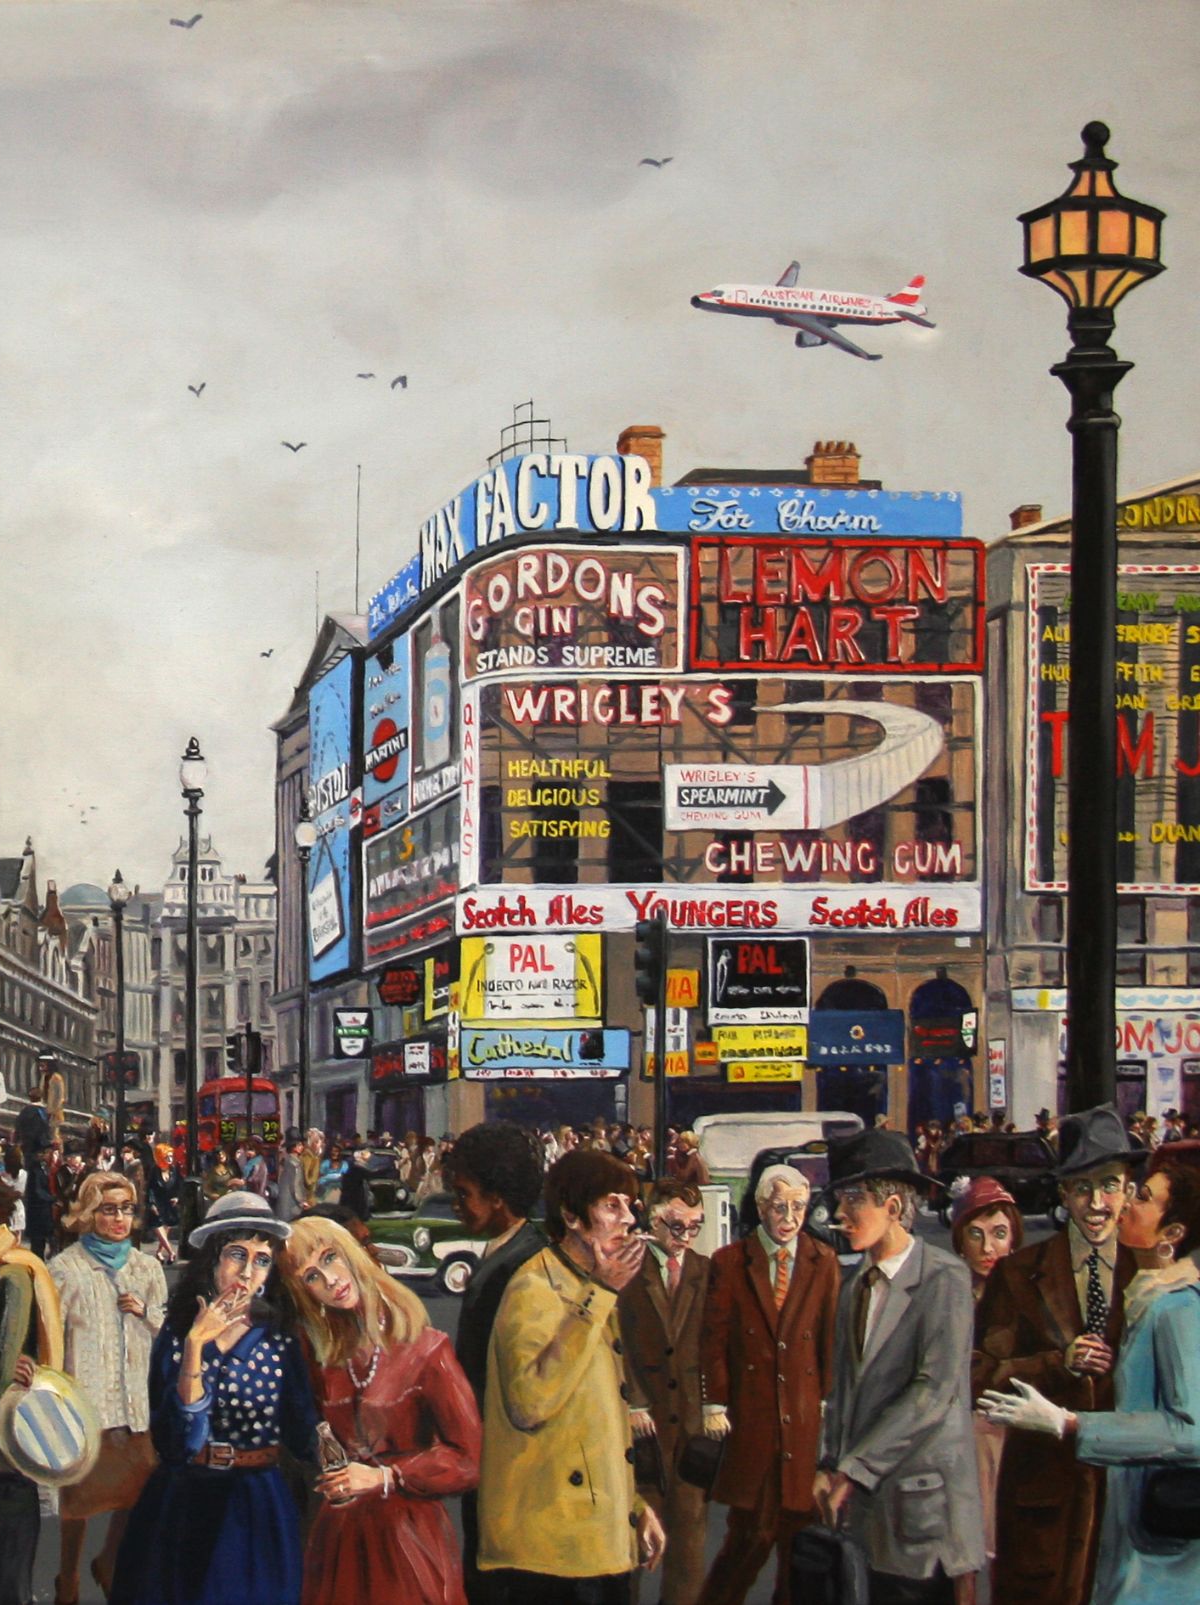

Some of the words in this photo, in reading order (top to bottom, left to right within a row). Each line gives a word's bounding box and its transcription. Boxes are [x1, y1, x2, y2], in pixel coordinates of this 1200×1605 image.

[419, 494, 465, 591] MAX
[475, 453, 658, 548] FACTOR
[688, 498, 755, 533] For
[776, 498, 882, 533] Charm
[719, 546, 948, 604] LEMON
[467, 552, 667, 642] GORDONS
[514, 605, 574, 635] GIN
[739, 604, 919, 663] HART
[476, 646, 550, 673] STANDS
[561, 645, 657, 667] SUPREME
[463, 702, 474, 856] QANTAS
[507, 760, 613, 780] HEALTHFUL
[506, 787, 601, 809] DELICIOUS
[680, 787, 770, 806] SPEARMINT
[509, 820, 612, 840] SATISFYING
[703, 841, 877, 876] CHEWING
[892, 841, 963, 876] GUM
[461, 895, 537, 930] Scotch
[546, 895, 605, 926] Ales
[625, 890, 779, 928] YOUNGERS
[808, 896, 898, 929] Scotch
[902, 897, 960, 929] Ales
[508, 943, 556, 974] PAL
[736, 944, 784, 975] PAL
